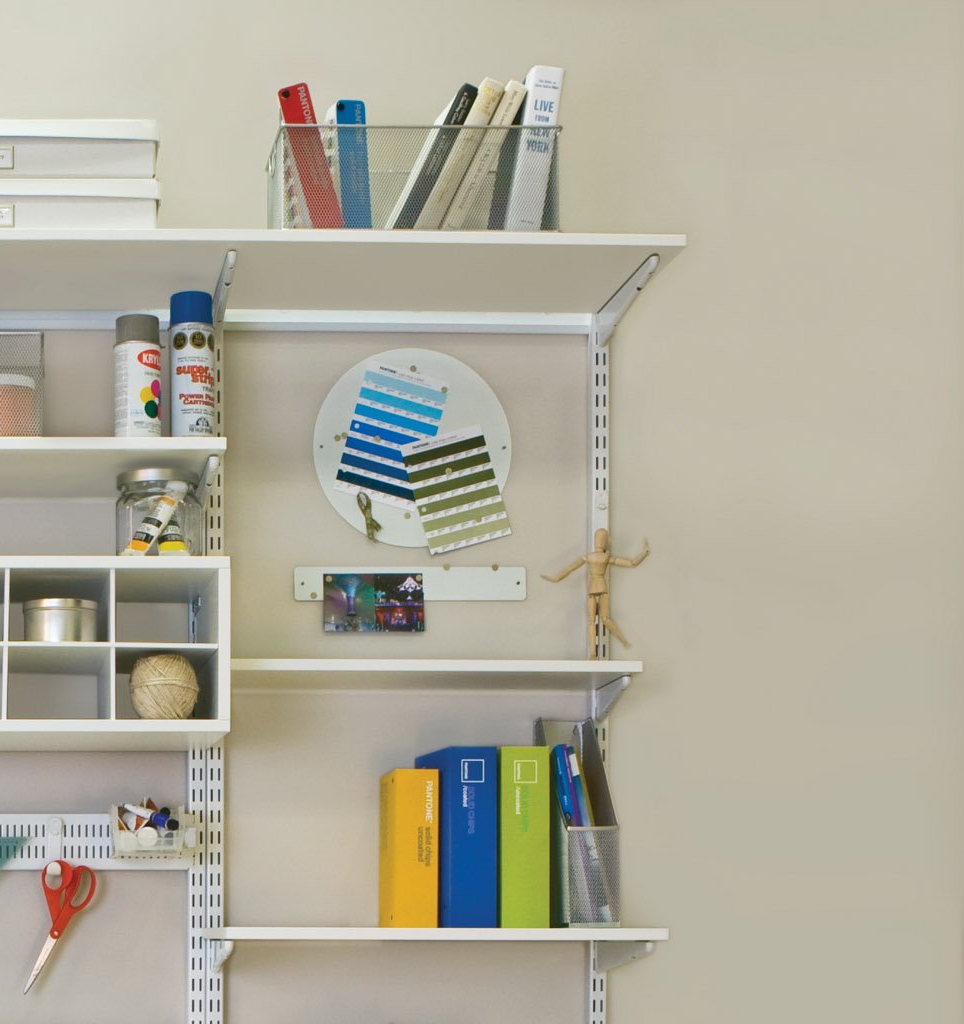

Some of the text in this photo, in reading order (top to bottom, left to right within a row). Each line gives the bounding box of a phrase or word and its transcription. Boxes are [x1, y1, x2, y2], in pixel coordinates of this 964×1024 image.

[297, 86, 314, 124] PANTON
[534, 99, 554, 113] LIVE
[527, 138, 550, 154] YORK
[425, 780, 433, 822] PANTONE
[467, 786, 475, 834] SOLID CHIPS
[417, 827, 425, 863] uncoated
